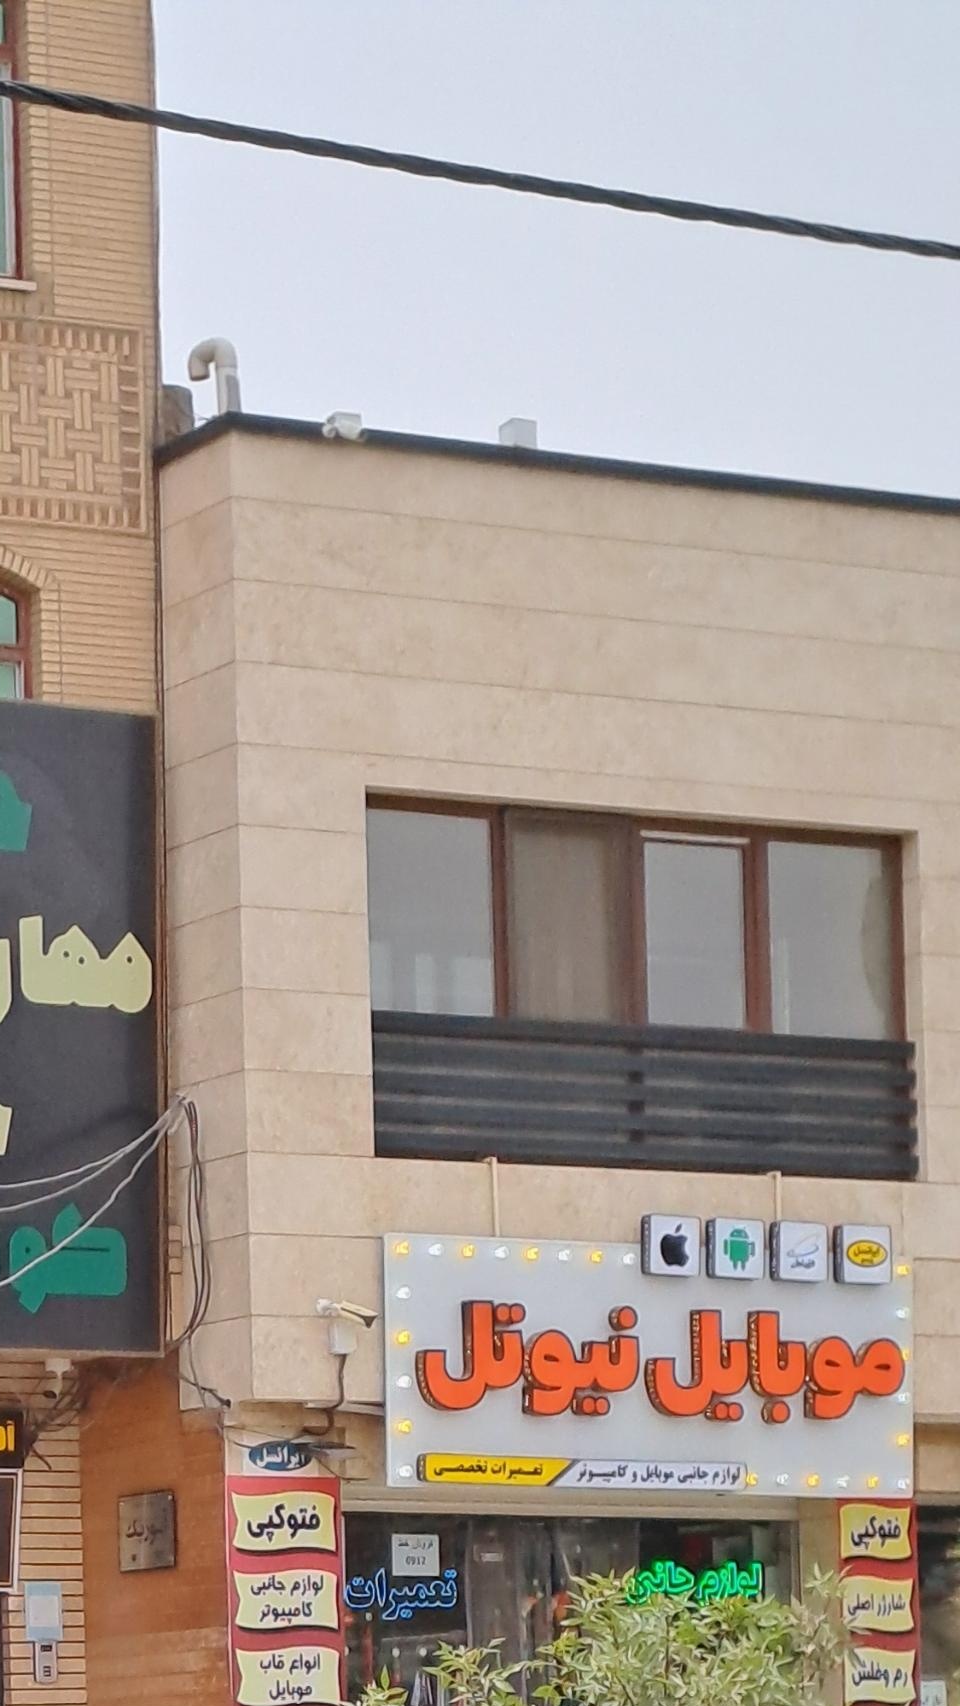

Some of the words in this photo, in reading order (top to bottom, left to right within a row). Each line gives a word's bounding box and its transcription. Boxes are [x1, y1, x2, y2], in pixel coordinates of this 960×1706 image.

[415, 1299, 641, 1418] نیوتل
[645, 1309, 906, 1425] موبایل
[434, 1460, 488, 1477] تخصصی
[491, 1460, 544, 1479] تعمیرات
[577, 1463, 628, 1484] کامپیوتر
[631, 1469, 638, 1483] و
[640, 1463, 674, 1483] موبایل
[678, 1463, 708, 1484] جانبی
[712, 1463, 741, 1486] لوازم
[247, 1503, 321, 1543] فتوکپی
[851, 1516, 901, 1550] فتوکپی
[251, 1575, 286, 1596] جانبی
[290, 1575, 324, 1596] لوازم
[344, 1567, 457, 1620] تعمیرات
[696, 1560, 763, 1605] لوازم
[260, 1601, 313, 1624] کامپیوتر
[848, 1593, 874, 1616] اصلی
[877, 1593, 906, 1616] شارژر
[260, 1653, 285, 1674] قاب
[290, 1653, 321, 1675] انواع
[893, 1666, 908, 1688] رم
[269, 1680, 313, 1701] موبایل
